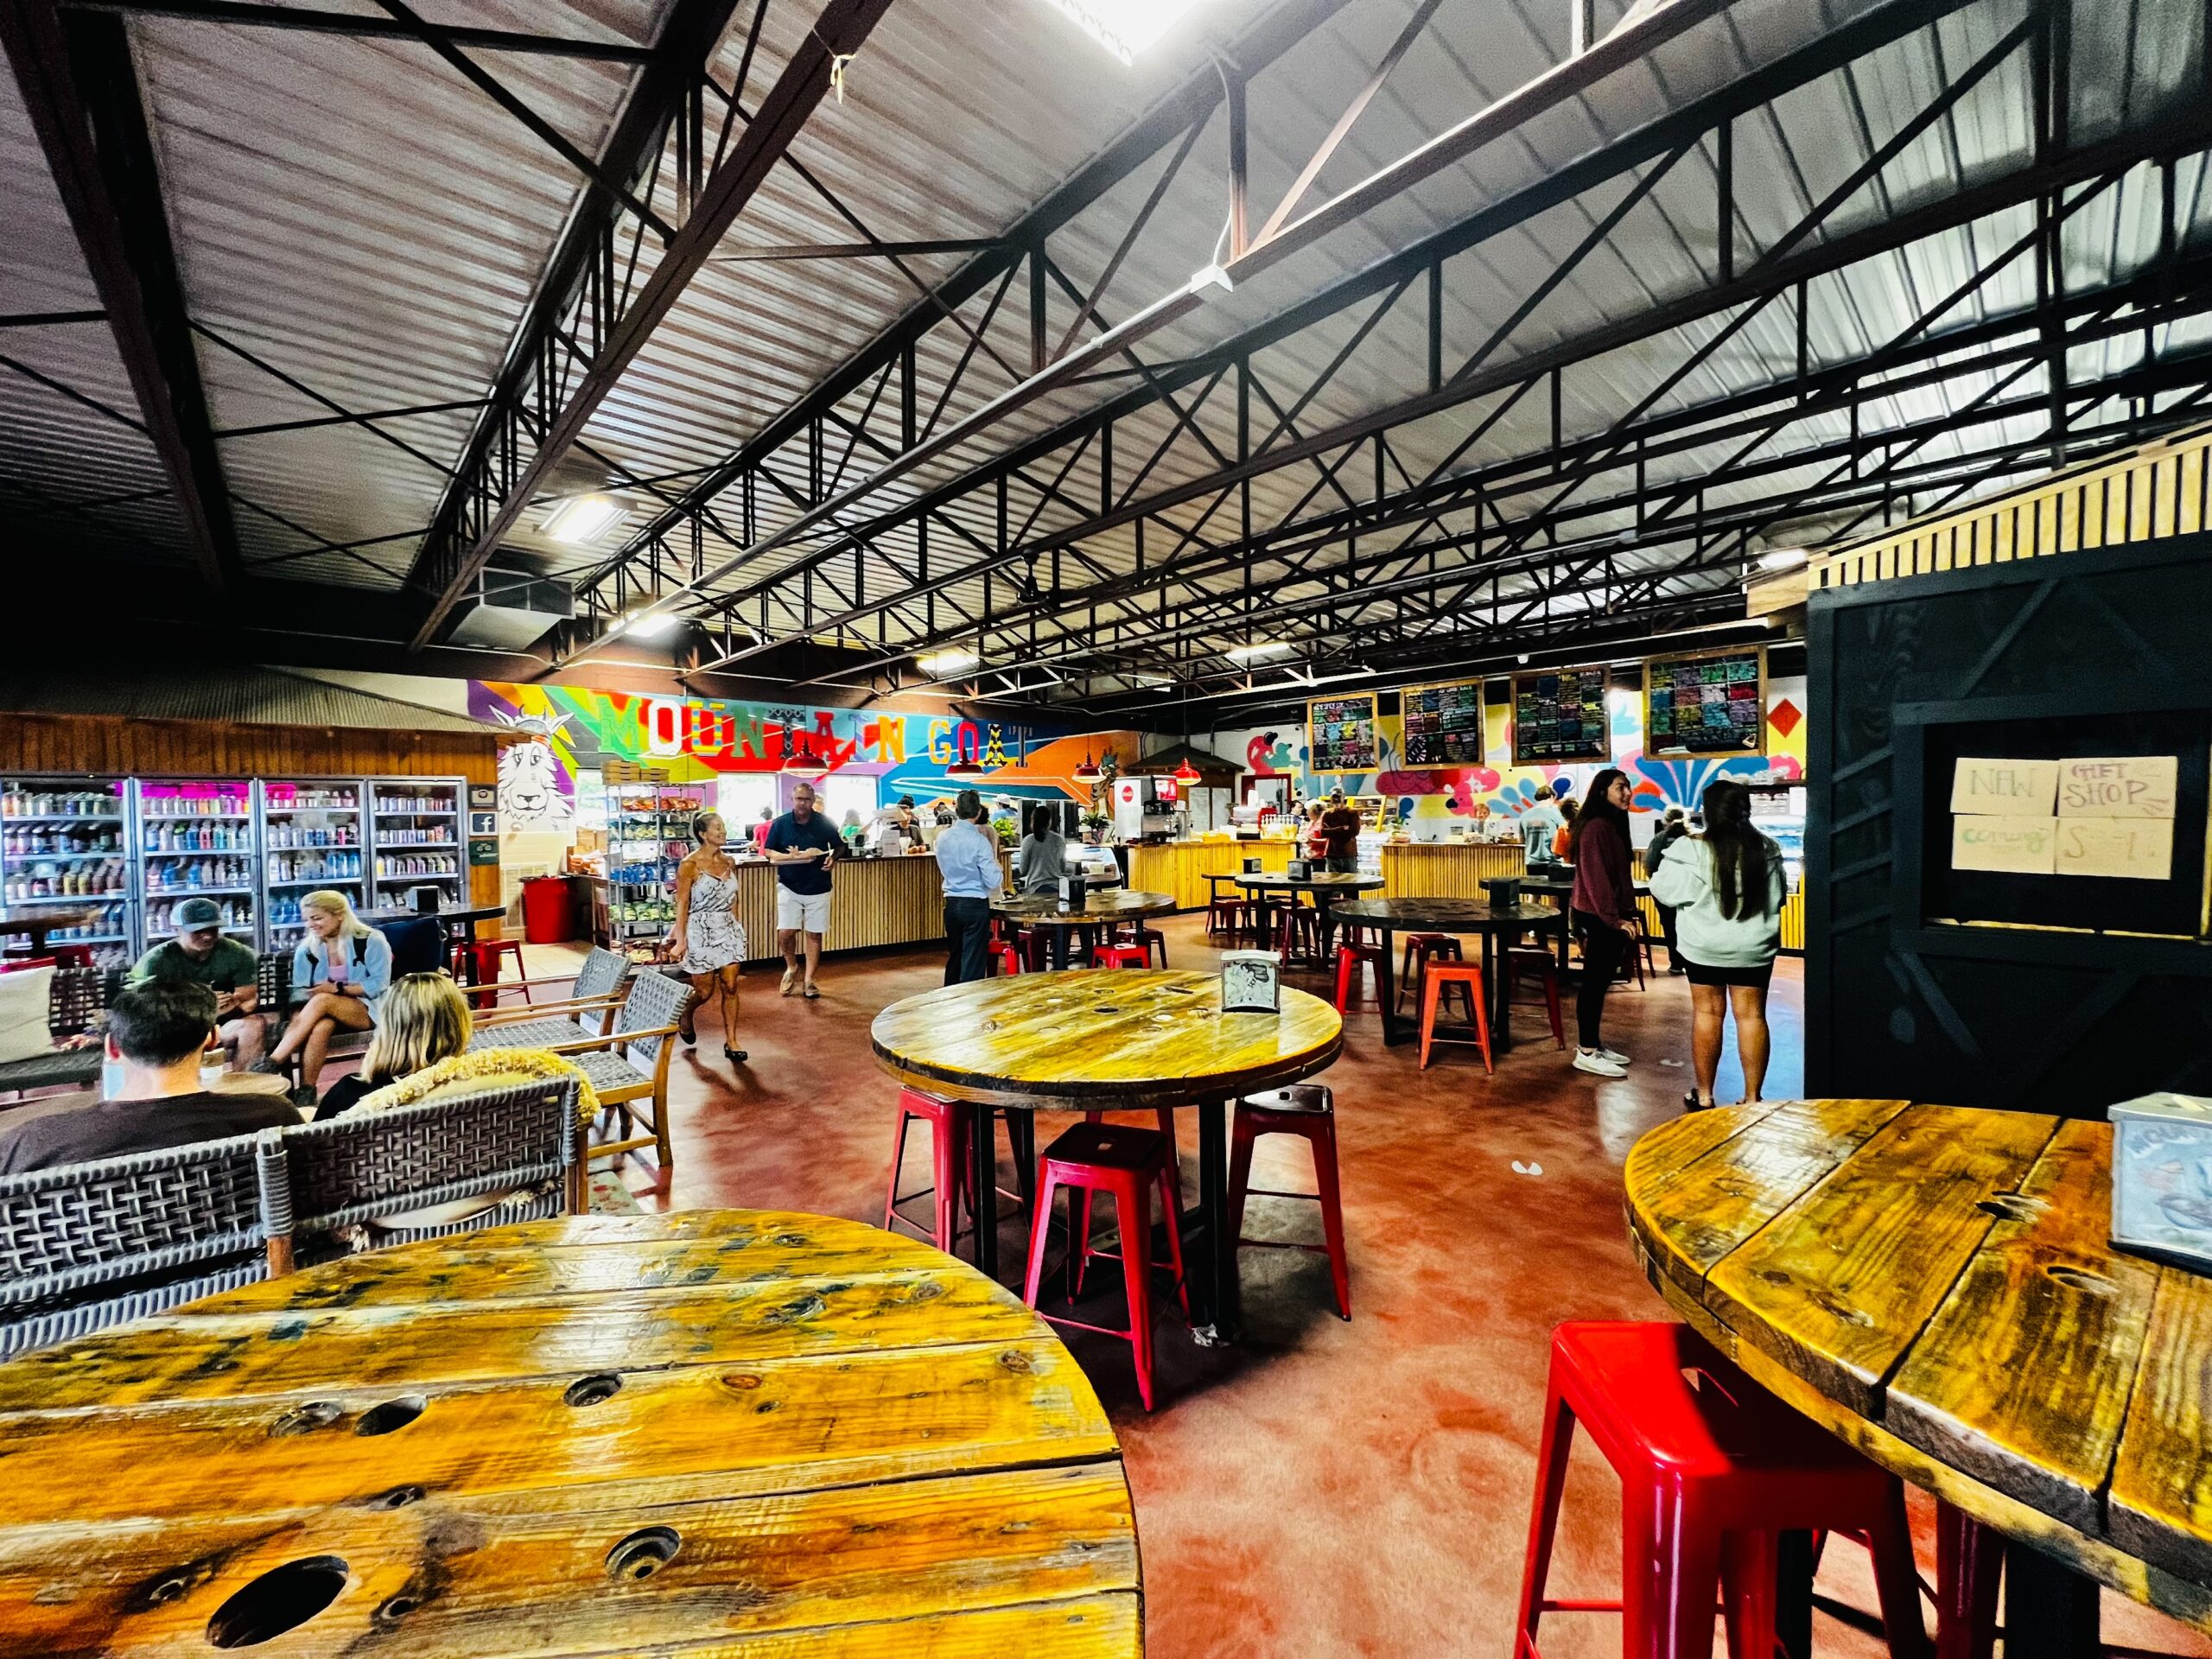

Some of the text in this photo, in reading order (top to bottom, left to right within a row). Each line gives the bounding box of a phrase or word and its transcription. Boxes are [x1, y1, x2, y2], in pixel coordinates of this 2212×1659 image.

[597, 694, 1034, 768] MOUNTAIN GOAT
[1969, 767, 2037, 798] NEW
[2063, 780, 2148, 808] SHOP
